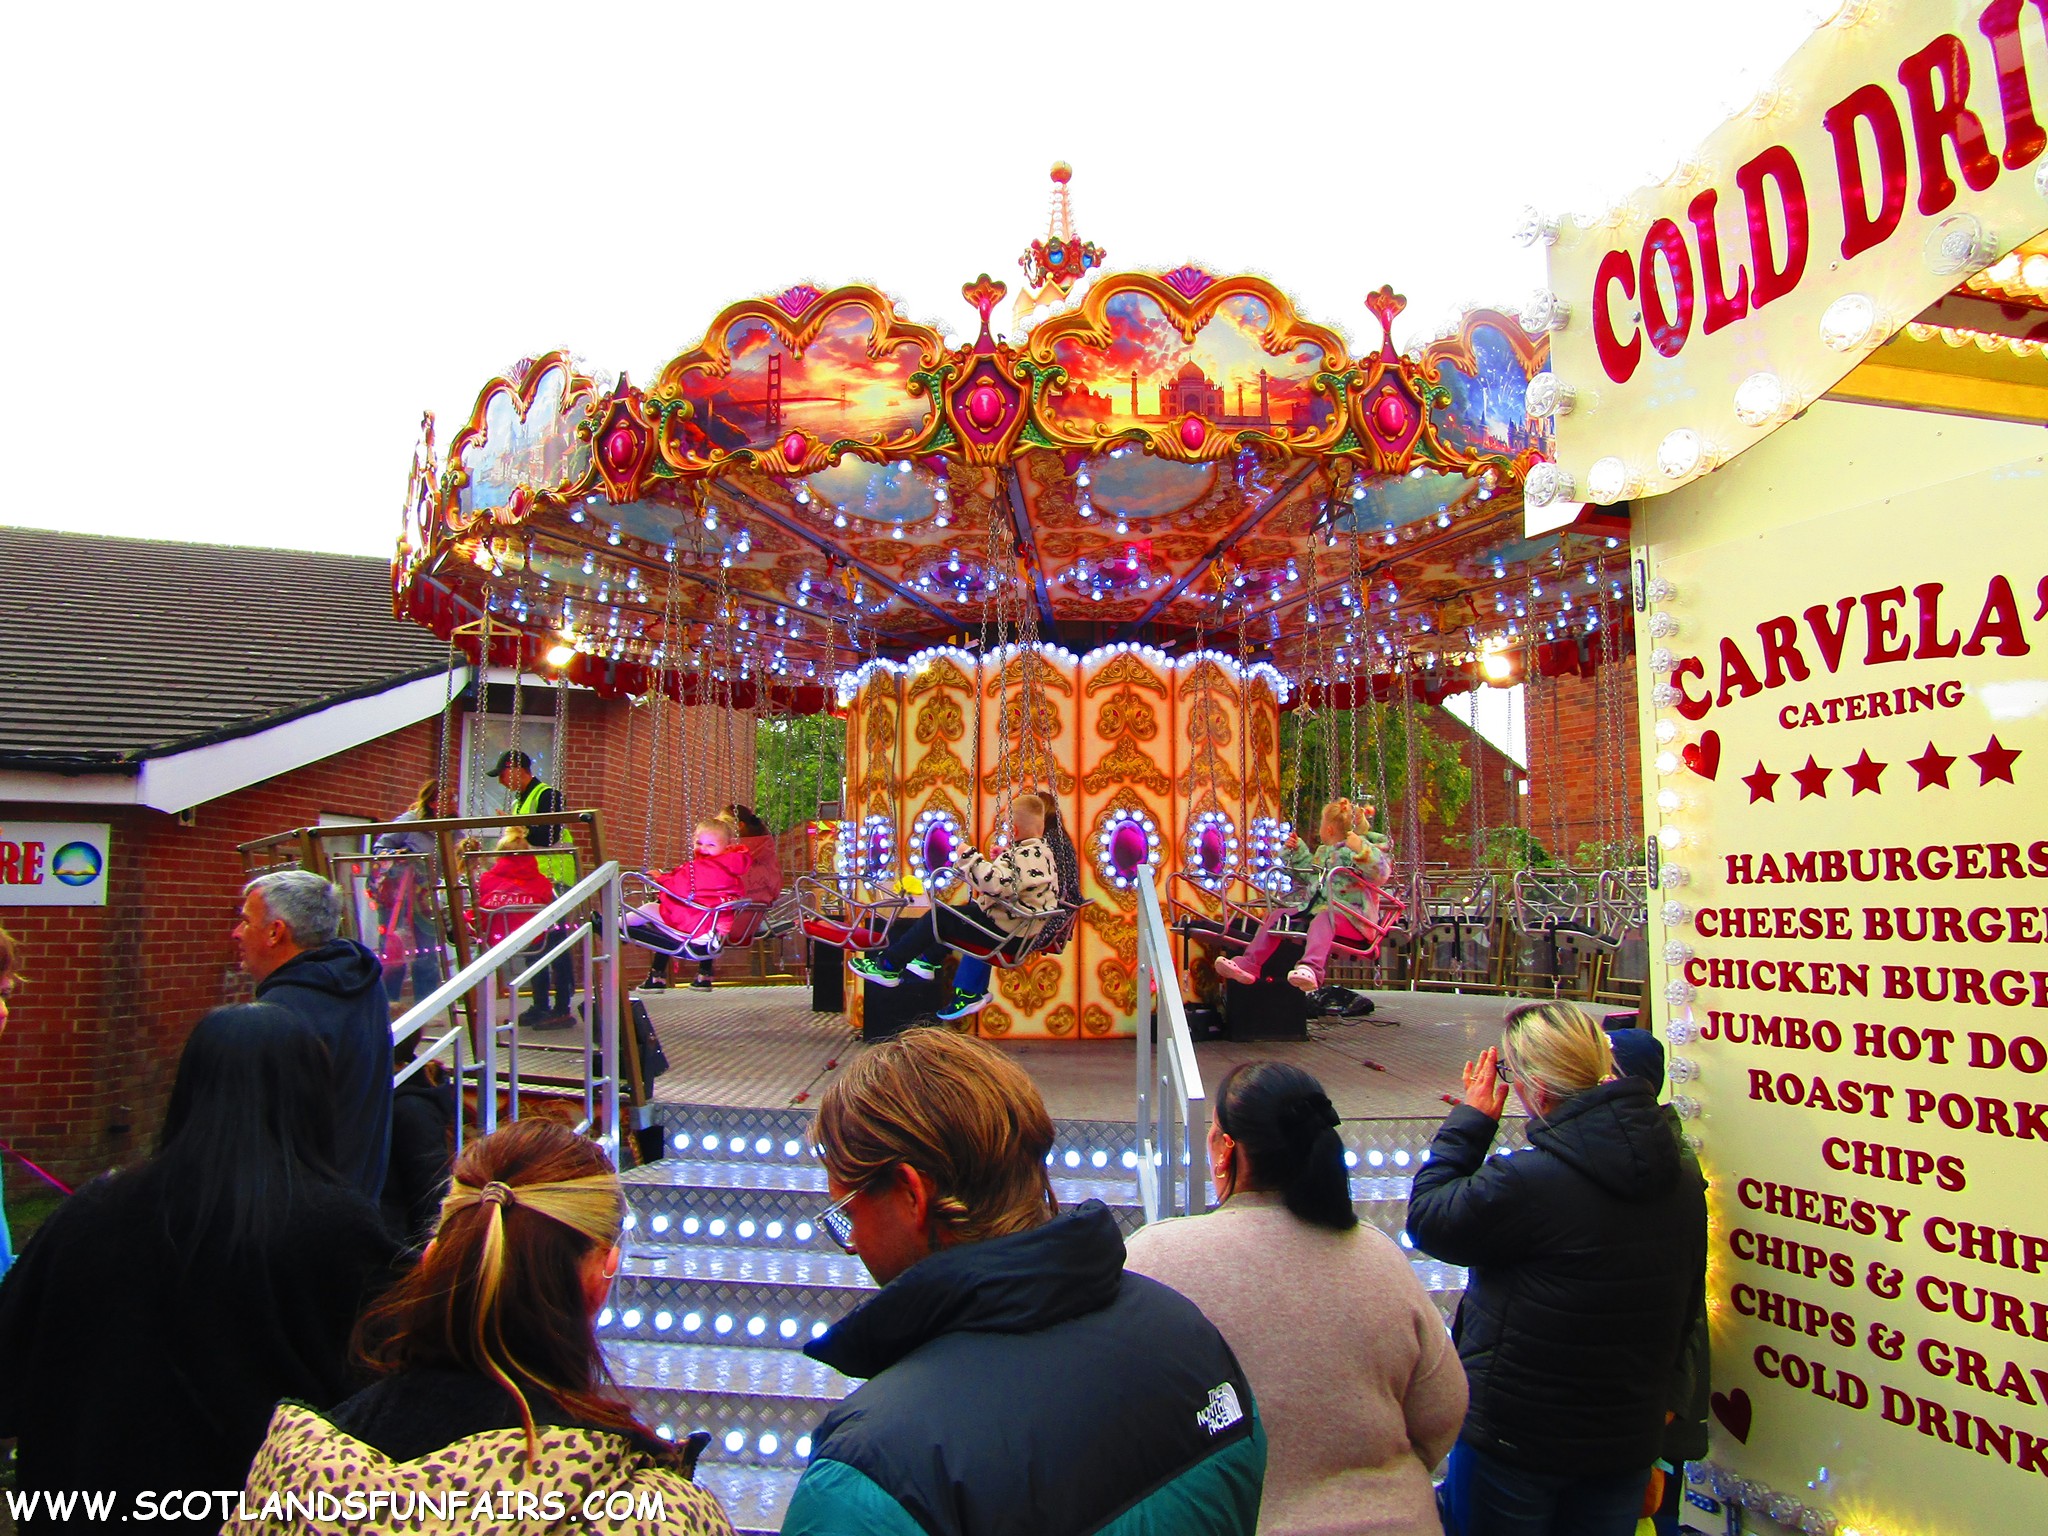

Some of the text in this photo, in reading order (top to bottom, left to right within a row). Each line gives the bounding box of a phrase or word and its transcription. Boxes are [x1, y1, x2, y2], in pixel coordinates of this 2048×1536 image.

[1592, 0, 2048, 384] COLD DRI
[1778, 680, 1965, 730] CATERING
[1725, 840, 2048, 885] HAMBURGERS
[1694, 906, 2048, 944] CHEESE BURGE
[1683, 957, 1870, 997] CHICKEN
[1700, 1010, 1842, 1053] JUMBO
[1852, 1022, 1955, 1064] HOT
[1747, 1068, 2048, 1143] ROAST PORK
[1821, 1136, 1966, 1192] CHIPS
[1737, 1177, 1911, 1242] CHEESY
[1728, 1228, 1854, 1288] CHIPS
[1865, 1261, 1903, 1299] &
[1730, 1283, 1855, 1347] CHIPS
[1866, 1322, 1905, 1361] &
[1196, 1400, 1226, 1427] NORTH
[1207, 1411, 1231, 1436] FACE
[1753, 1344, 2048, 1477] COLD DRINK
